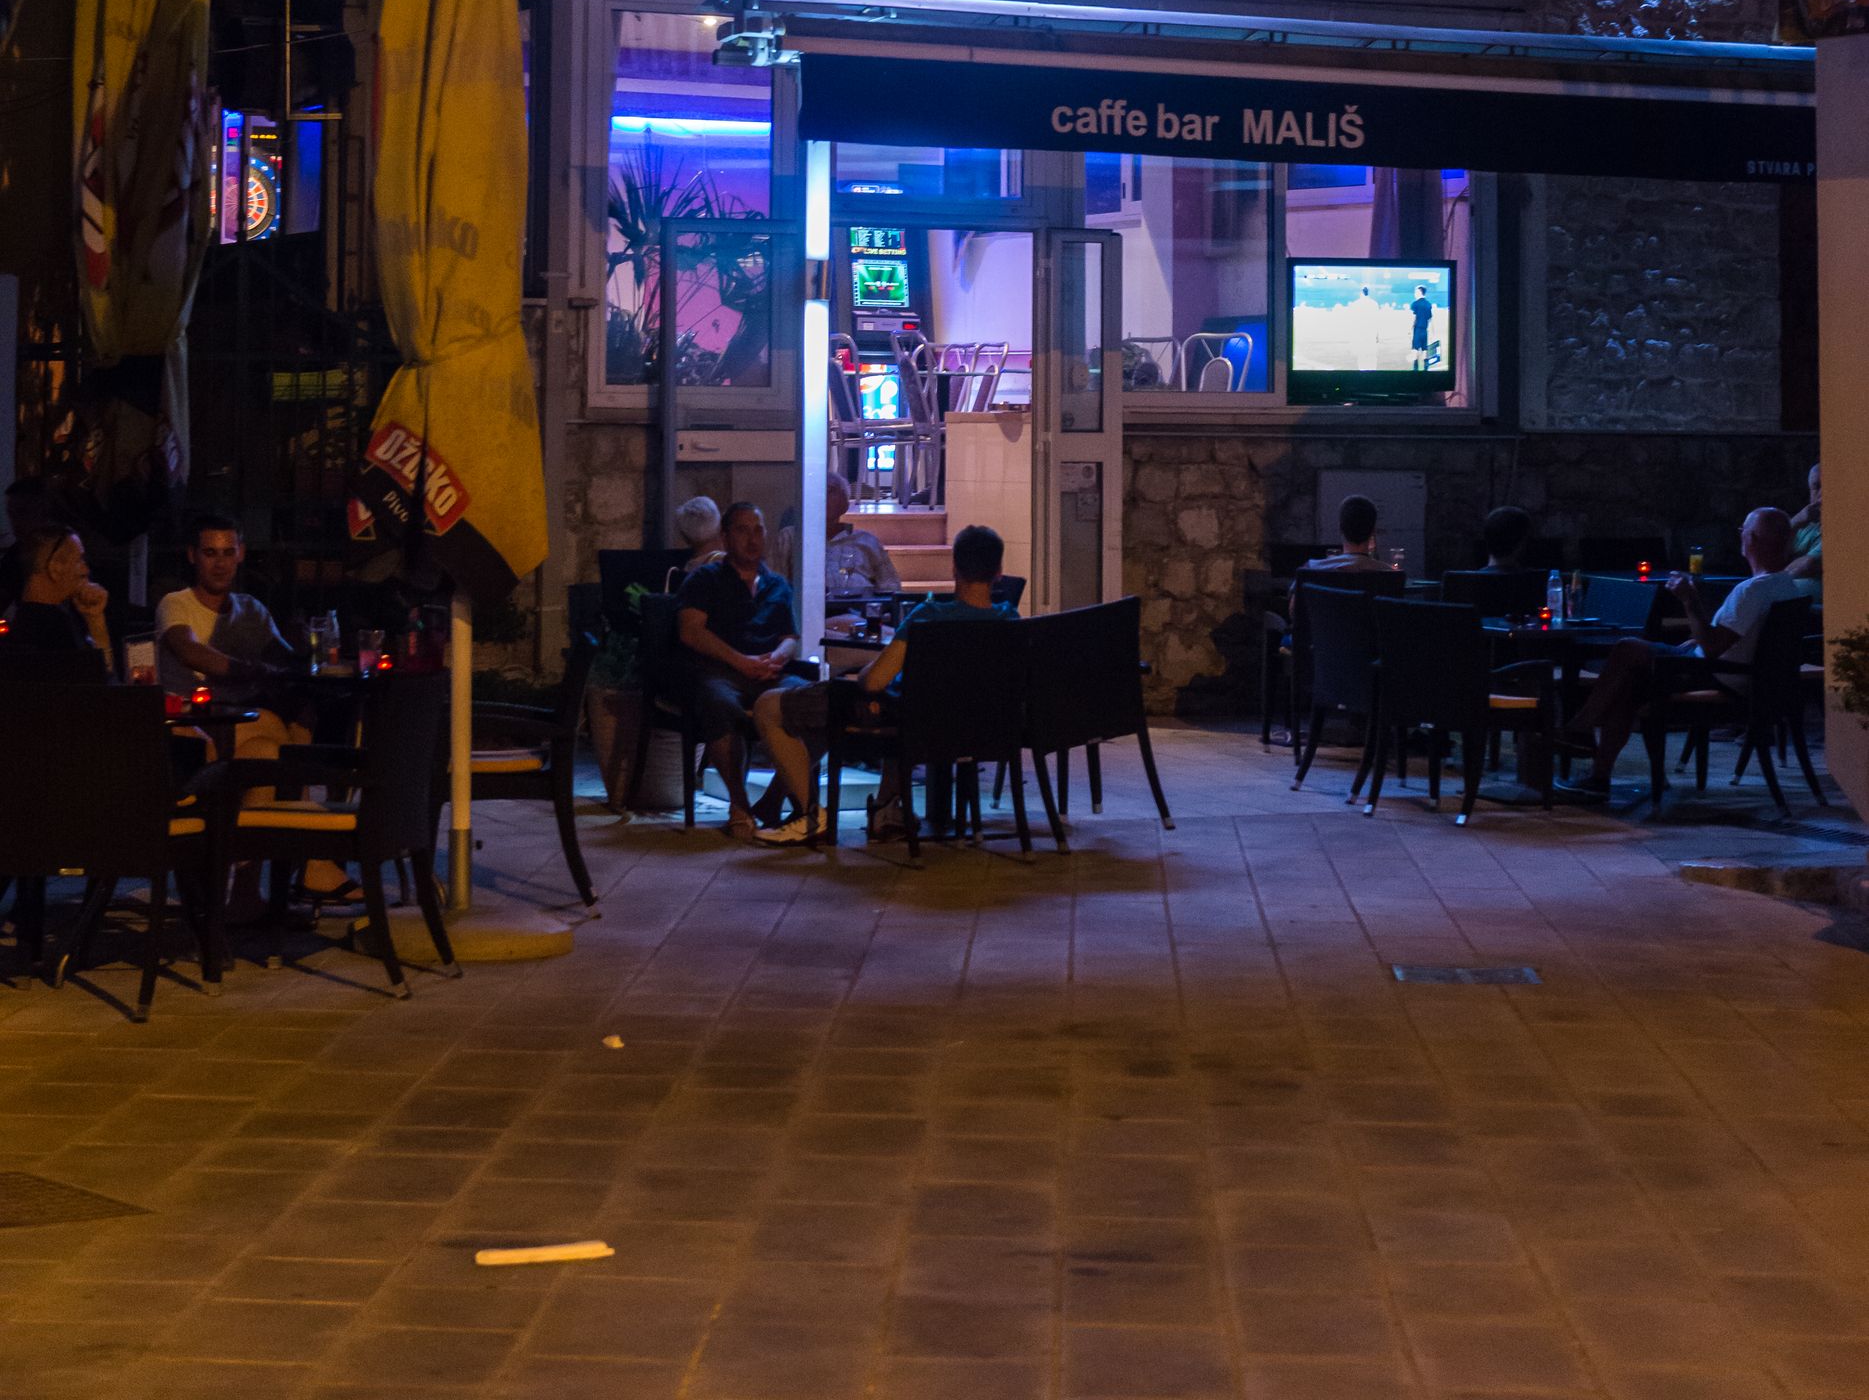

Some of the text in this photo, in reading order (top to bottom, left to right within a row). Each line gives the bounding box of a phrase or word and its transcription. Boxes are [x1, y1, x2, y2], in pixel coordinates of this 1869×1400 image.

[1051, 99, 1366, 150] caffe bar MALIŠ
